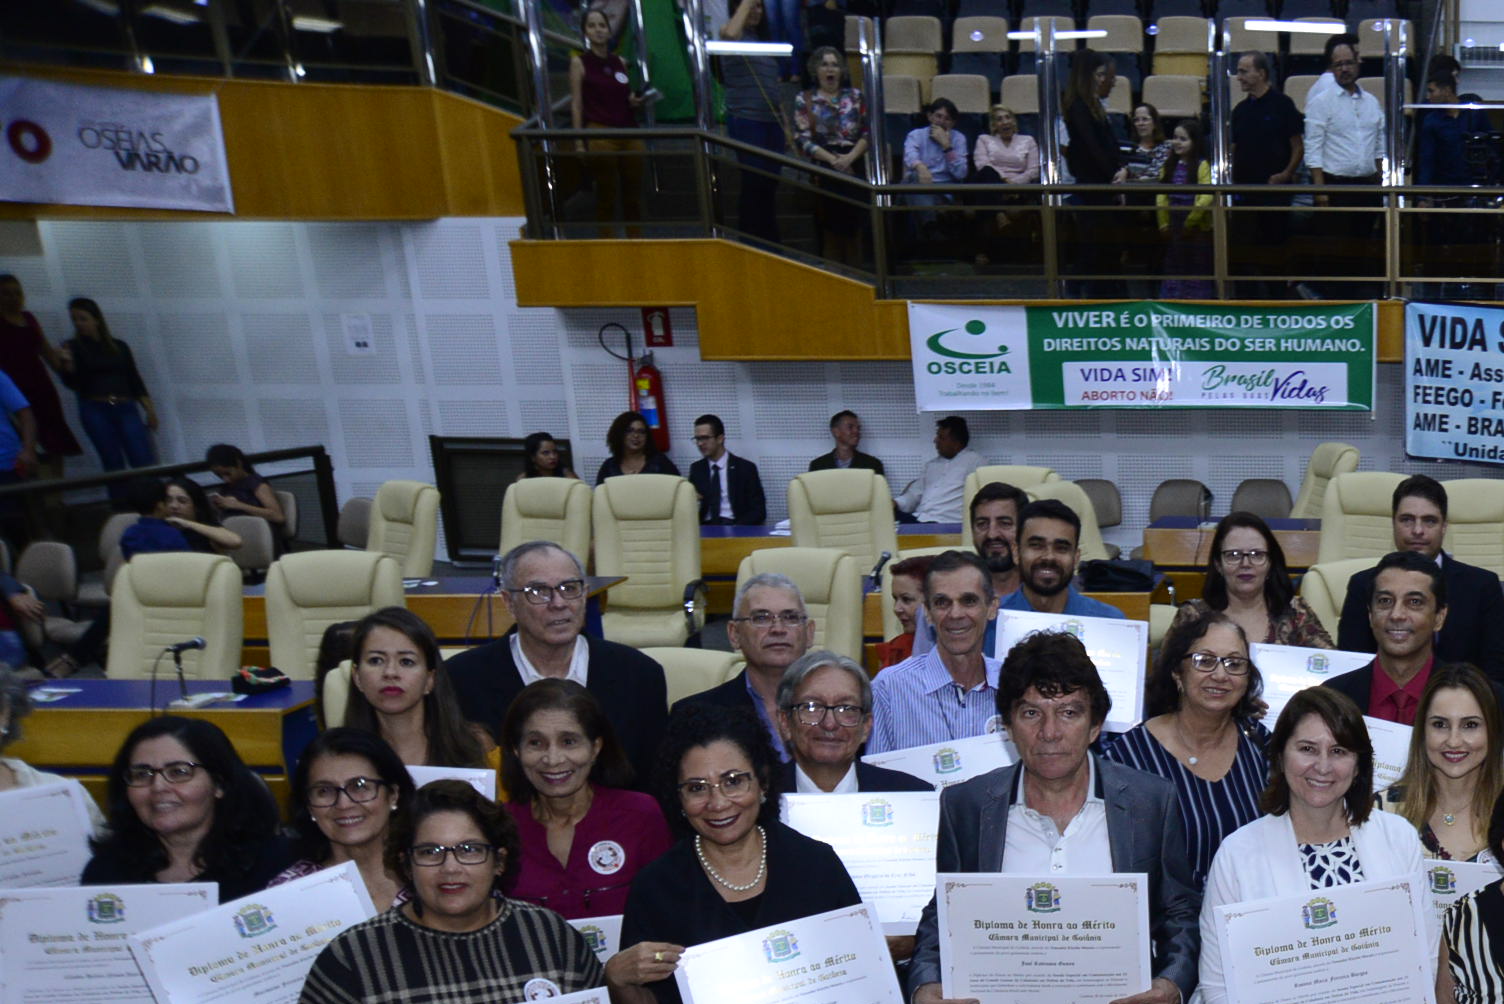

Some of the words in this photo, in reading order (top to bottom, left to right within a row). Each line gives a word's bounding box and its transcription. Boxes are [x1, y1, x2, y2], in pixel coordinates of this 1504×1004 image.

[1052, 311, 1116, 328] VIVER
[1120, 311, 1130, 327] É
[1134, 314, 1147, 327] O
[1151, 314, 1236, 328] PRIMEIRO
[1240, 315, 1263, 328] DE
[1267, 316, 1327, 328] TODOS
[1330, 316, 1354, 328] OS
[1418, 313, 1488, 352] VIDA
[1043, 338, 1121, 351] DIREITOS
[1125, 337, 1210, 351] NATURAIS
[1215, 338, 1240, 350] DO
[1244, 338, 1276, 351] SER
[1280, 338, 1366, 352] HUMANO.
[927, 361, 1012, 375] OSCEIA
[1080, 367, 1126, 382] VIDA
[1132, 367, 1173, 382] SIM!
[1201, 364, 1276, 391] Brasil
[1413, 358, 1453, 379] AME
[1082, 391, 1136, 400] ABORTO
[1270, 370, 1330, 402] Vidas
[1413, 385, 1473, 408] FEEGO
[1413, 412, 1450, 433] AME
[974, 920, 1014, 930] Diploma
[1018, 920, 1028, 929] de
[1031, 920, 1063, 930] Honra
[1067, 922, 1078, 930] ao
[1082, 919, 1116, 930] Mérito
[1254, 943, 1294, 956] Diploma
[1297, 940, 1307, 949] de
[1311, 935, 1341, 947] Honra
[1345, 932, 1356, 941] ao
[1359, 926, 1391, 938] Mérito
